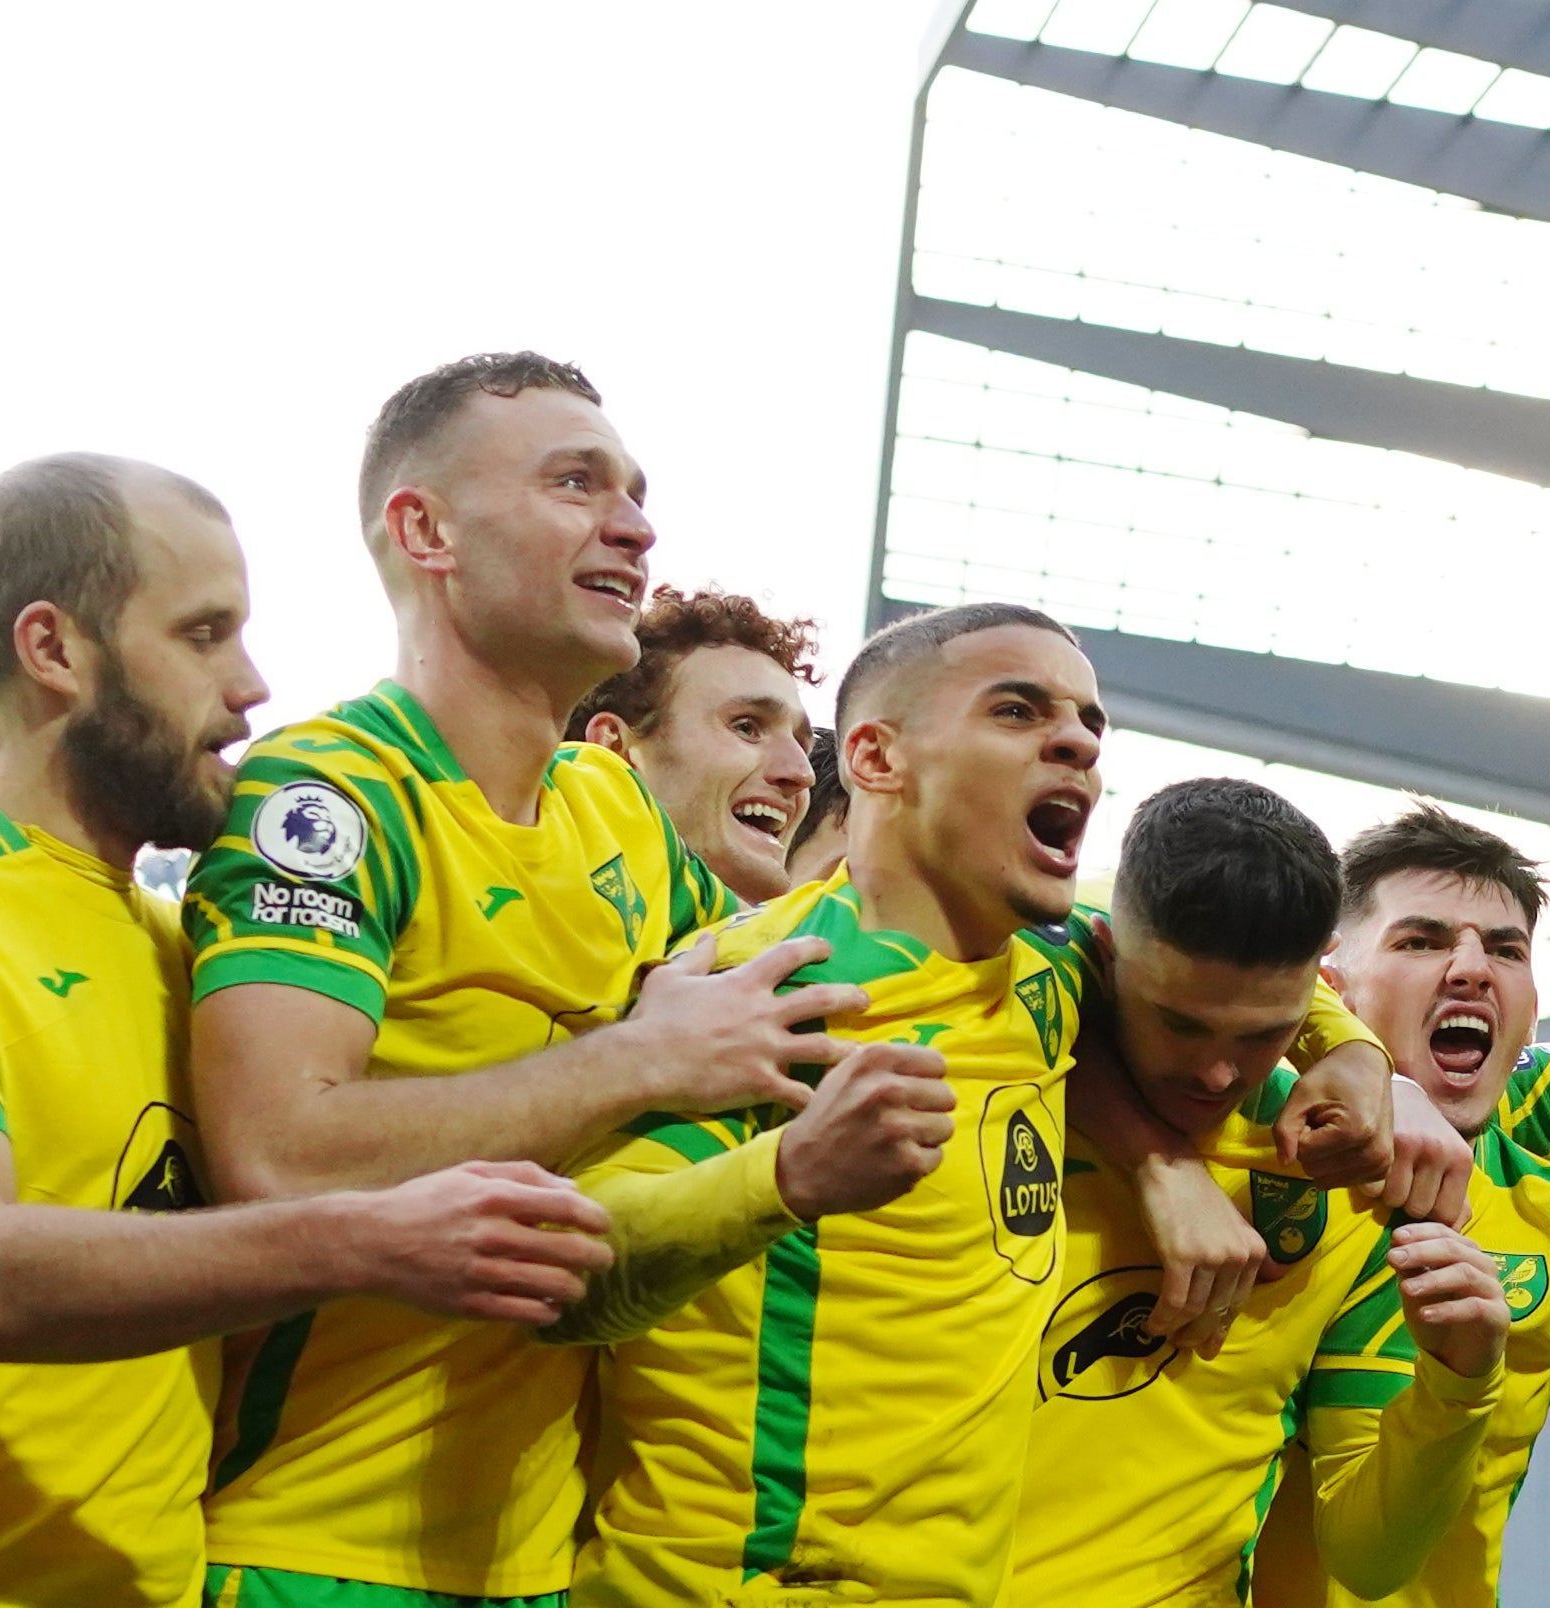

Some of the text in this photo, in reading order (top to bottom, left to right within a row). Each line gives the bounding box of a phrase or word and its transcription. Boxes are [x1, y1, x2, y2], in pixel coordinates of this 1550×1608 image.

[252, 902, 290, 924] for
[253, 882, 354, 918] No room
[1004, 1180, 1059, 1218] LOTUS
